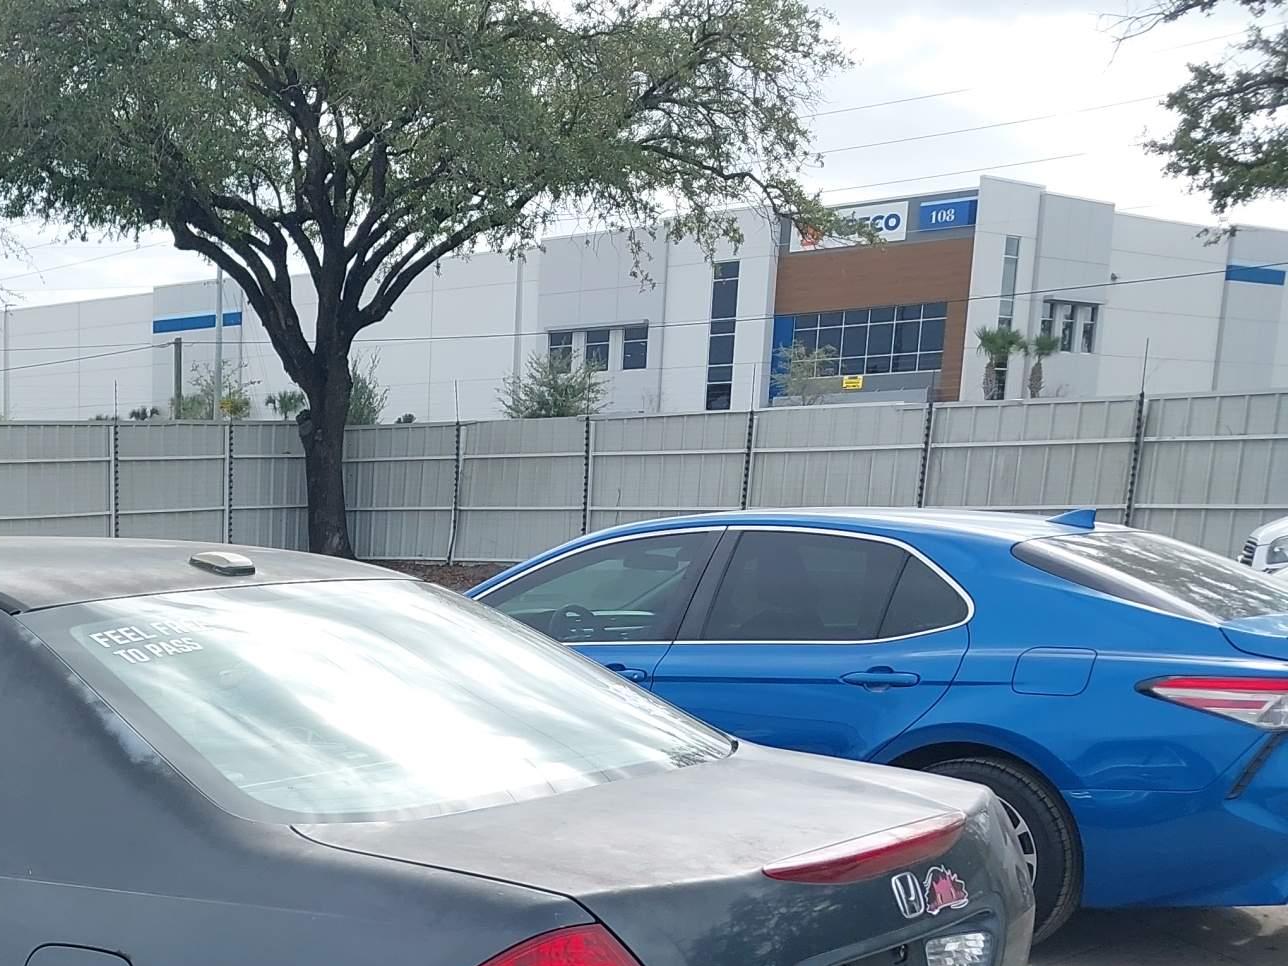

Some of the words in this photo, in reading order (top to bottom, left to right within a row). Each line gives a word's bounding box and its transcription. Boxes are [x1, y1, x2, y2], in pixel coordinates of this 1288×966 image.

[929, 209, 955, 224] 108
[89, 626, 158, 649] FEEL
[149, 616, 211, 636] FR
[112, 648, 152, 664] TO
[144, 637, 204, 657] PASS
